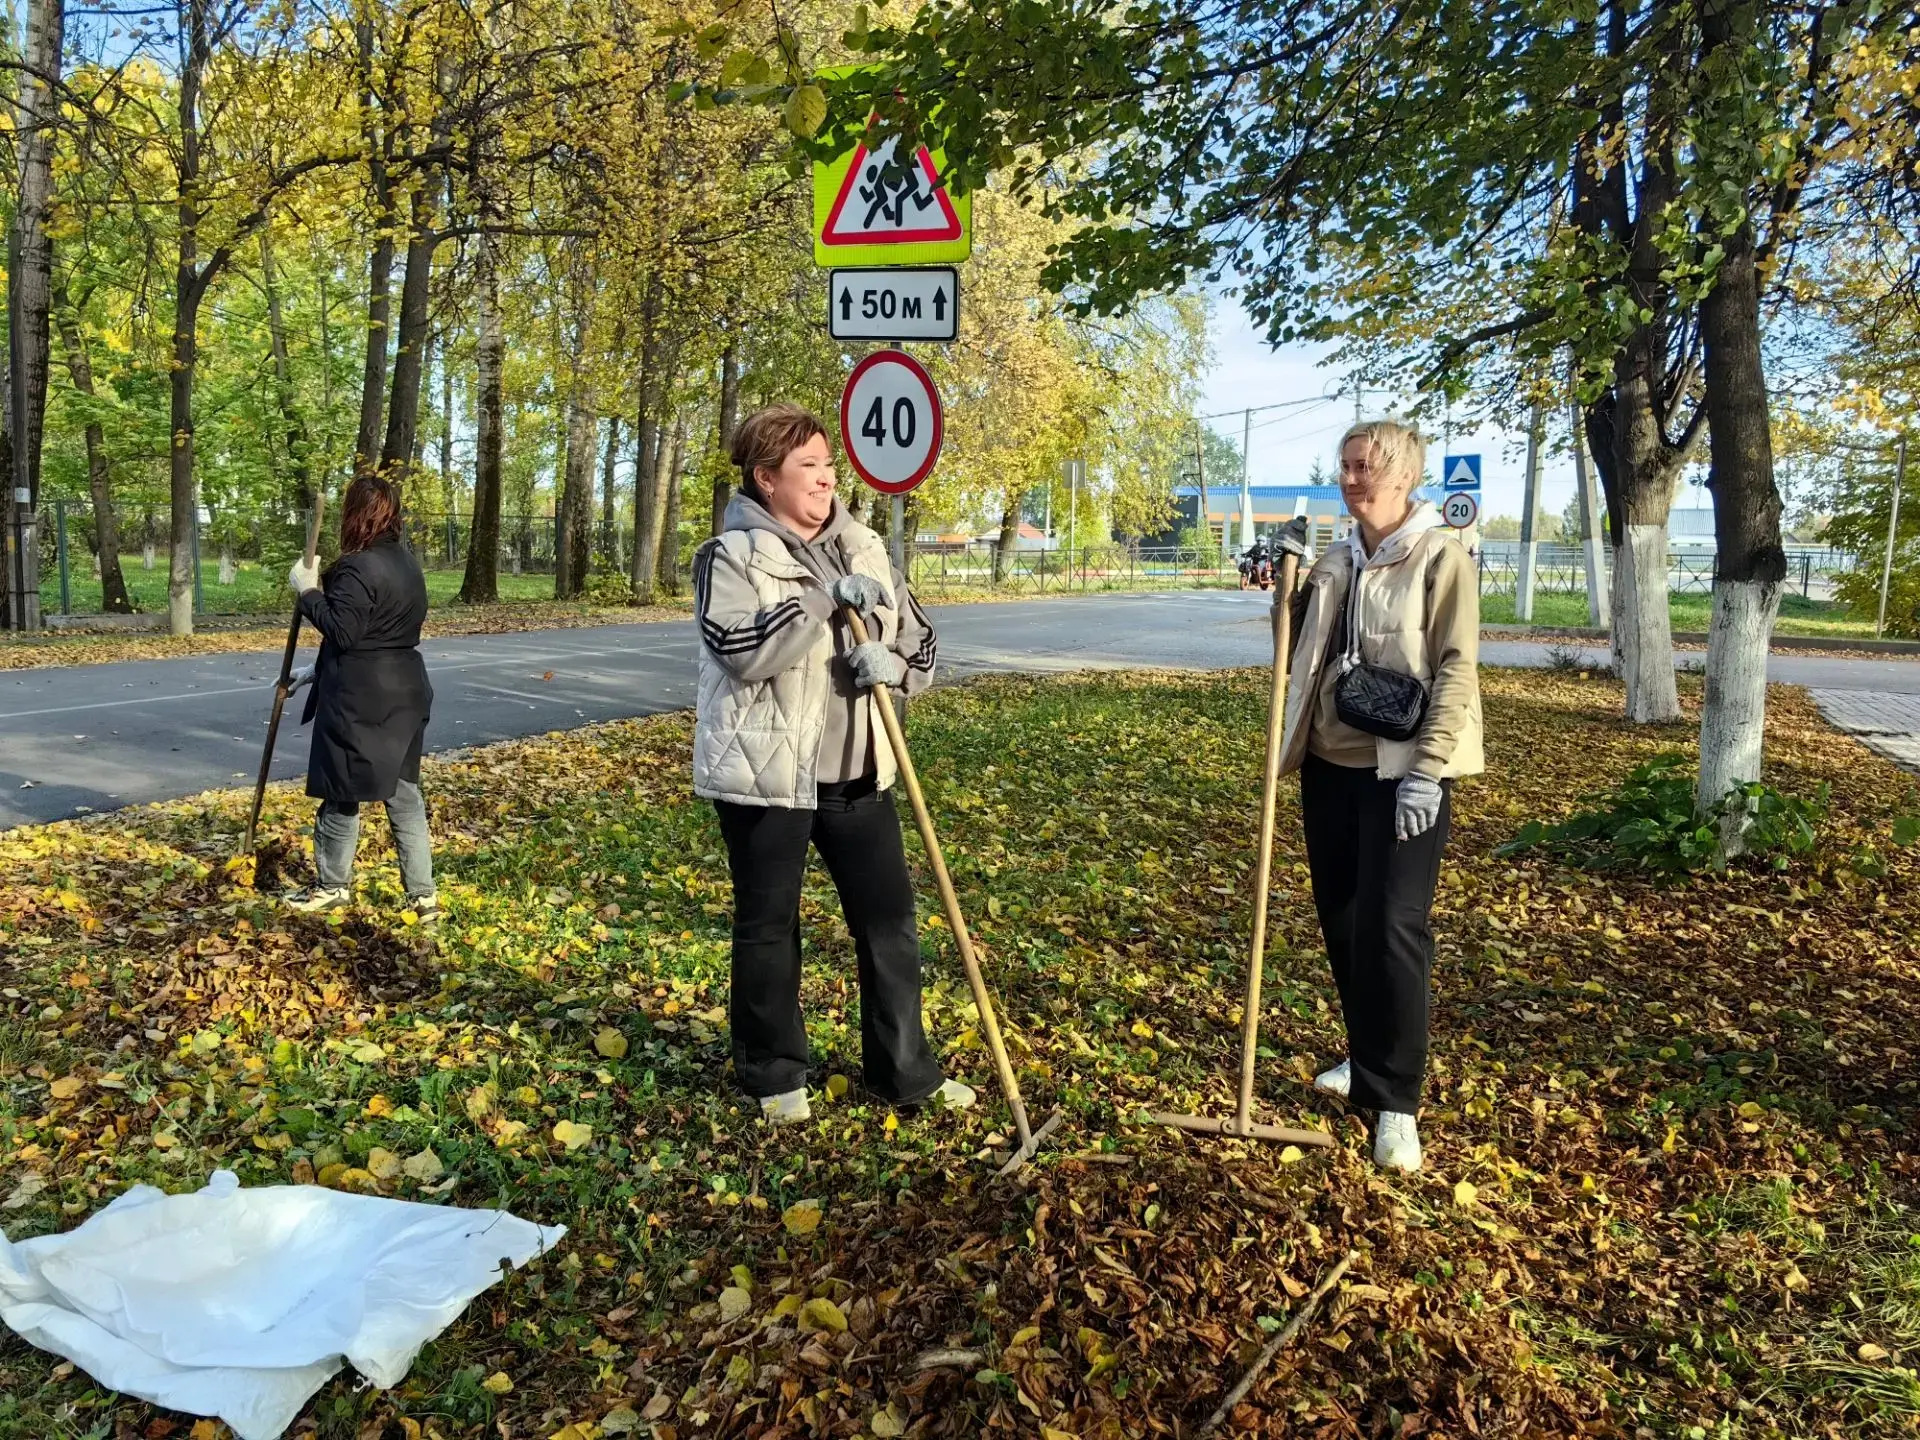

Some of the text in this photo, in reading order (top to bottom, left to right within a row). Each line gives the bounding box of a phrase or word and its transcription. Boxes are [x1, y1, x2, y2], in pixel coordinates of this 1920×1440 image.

[861, 289, 897, 319] 50
[861, 396, 916, 448] 40
[1451, 503, 1469, 517] 20
